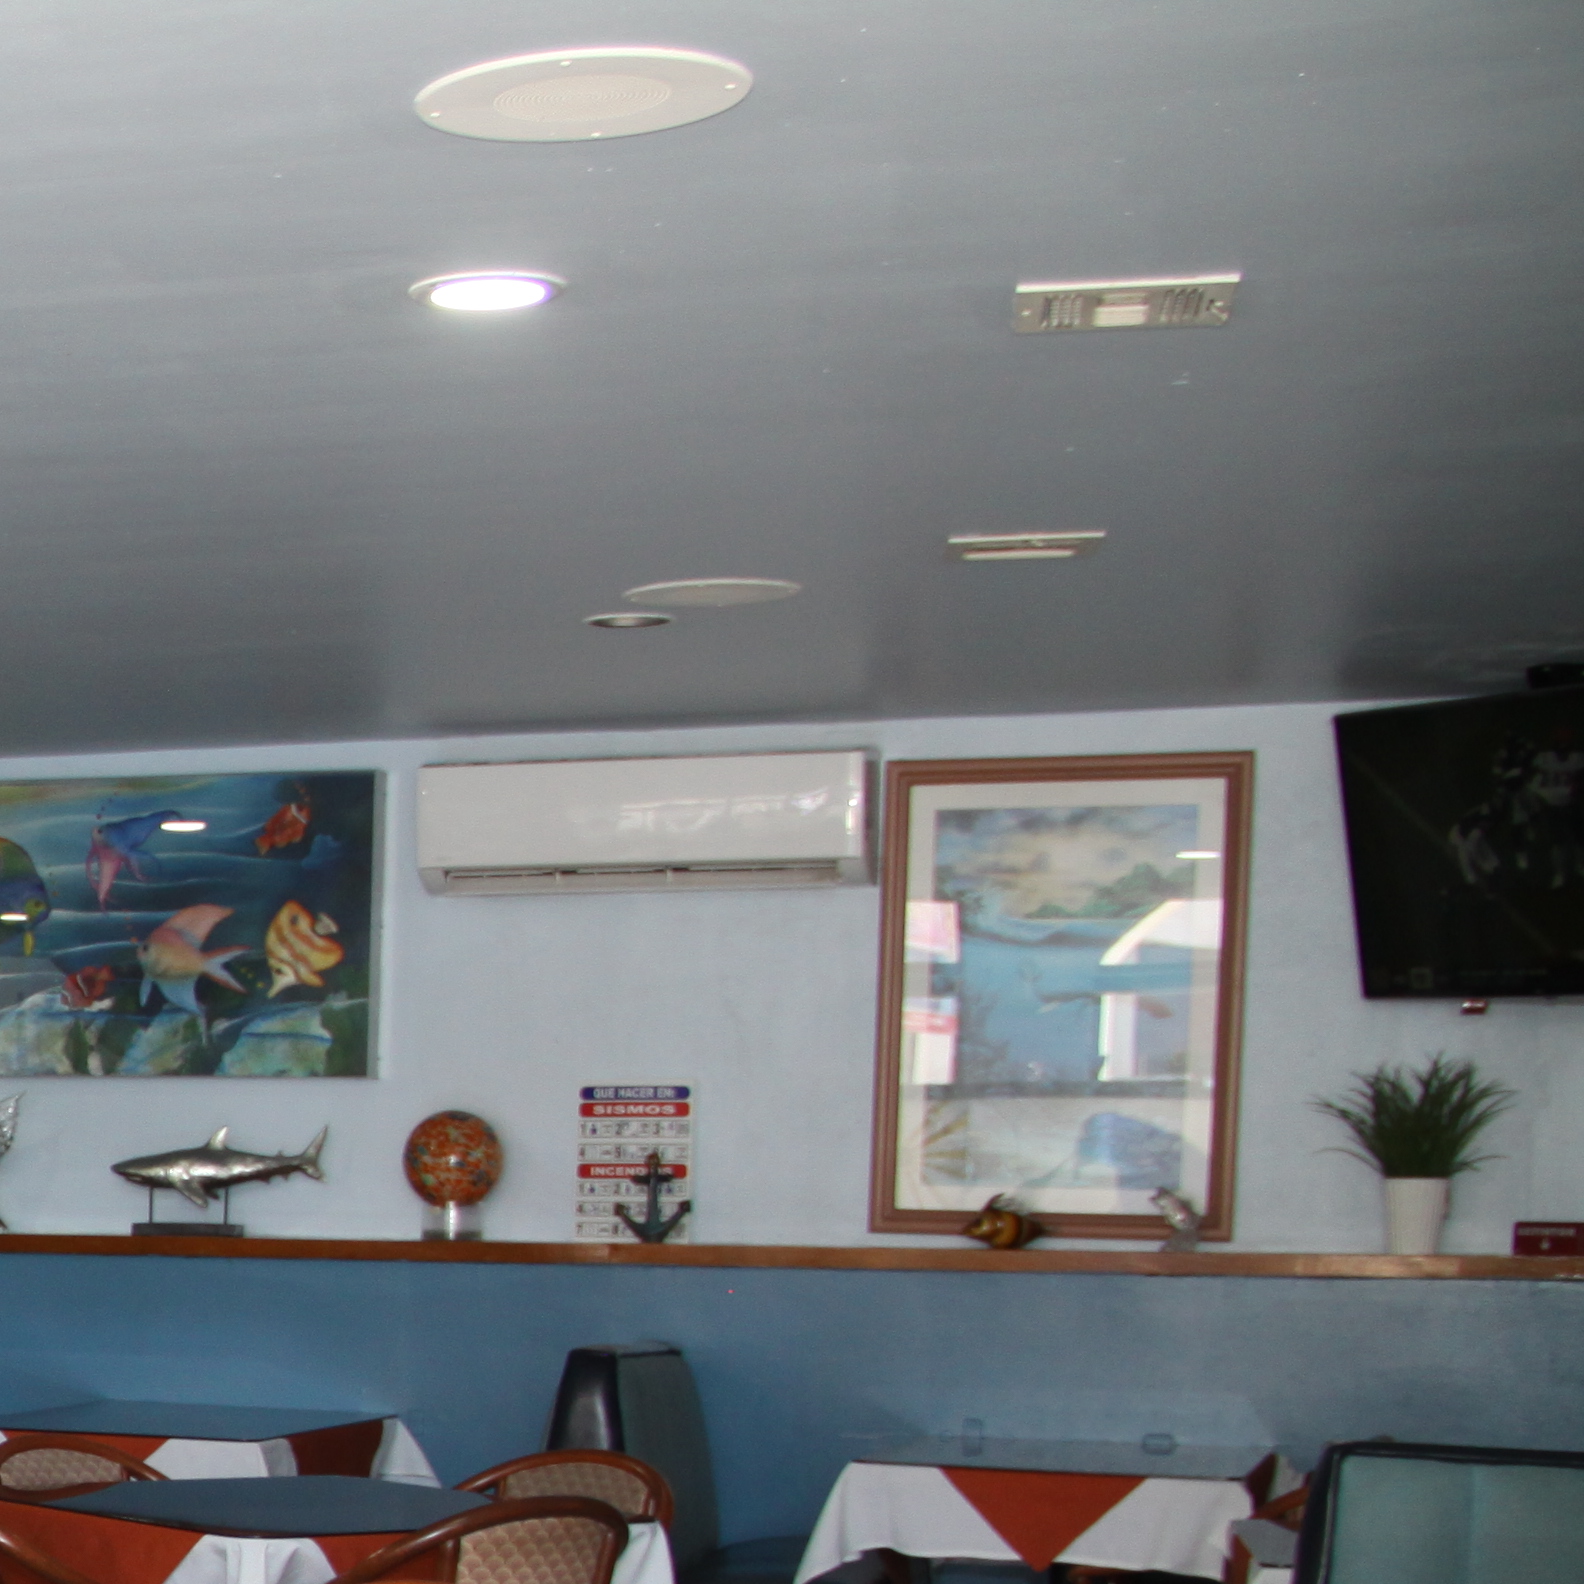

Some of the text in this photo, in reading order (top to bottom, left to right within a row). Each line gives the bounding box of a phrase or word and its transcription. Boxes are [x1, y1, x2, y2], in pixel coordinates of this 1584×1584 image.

[593, 1087, 615, 1098] QUE
[617, 1087, 654, 1098] HACER
[593, 1105, 675, 1115] SISMOS
[590, 1166, 673, 1176] INCENDS
